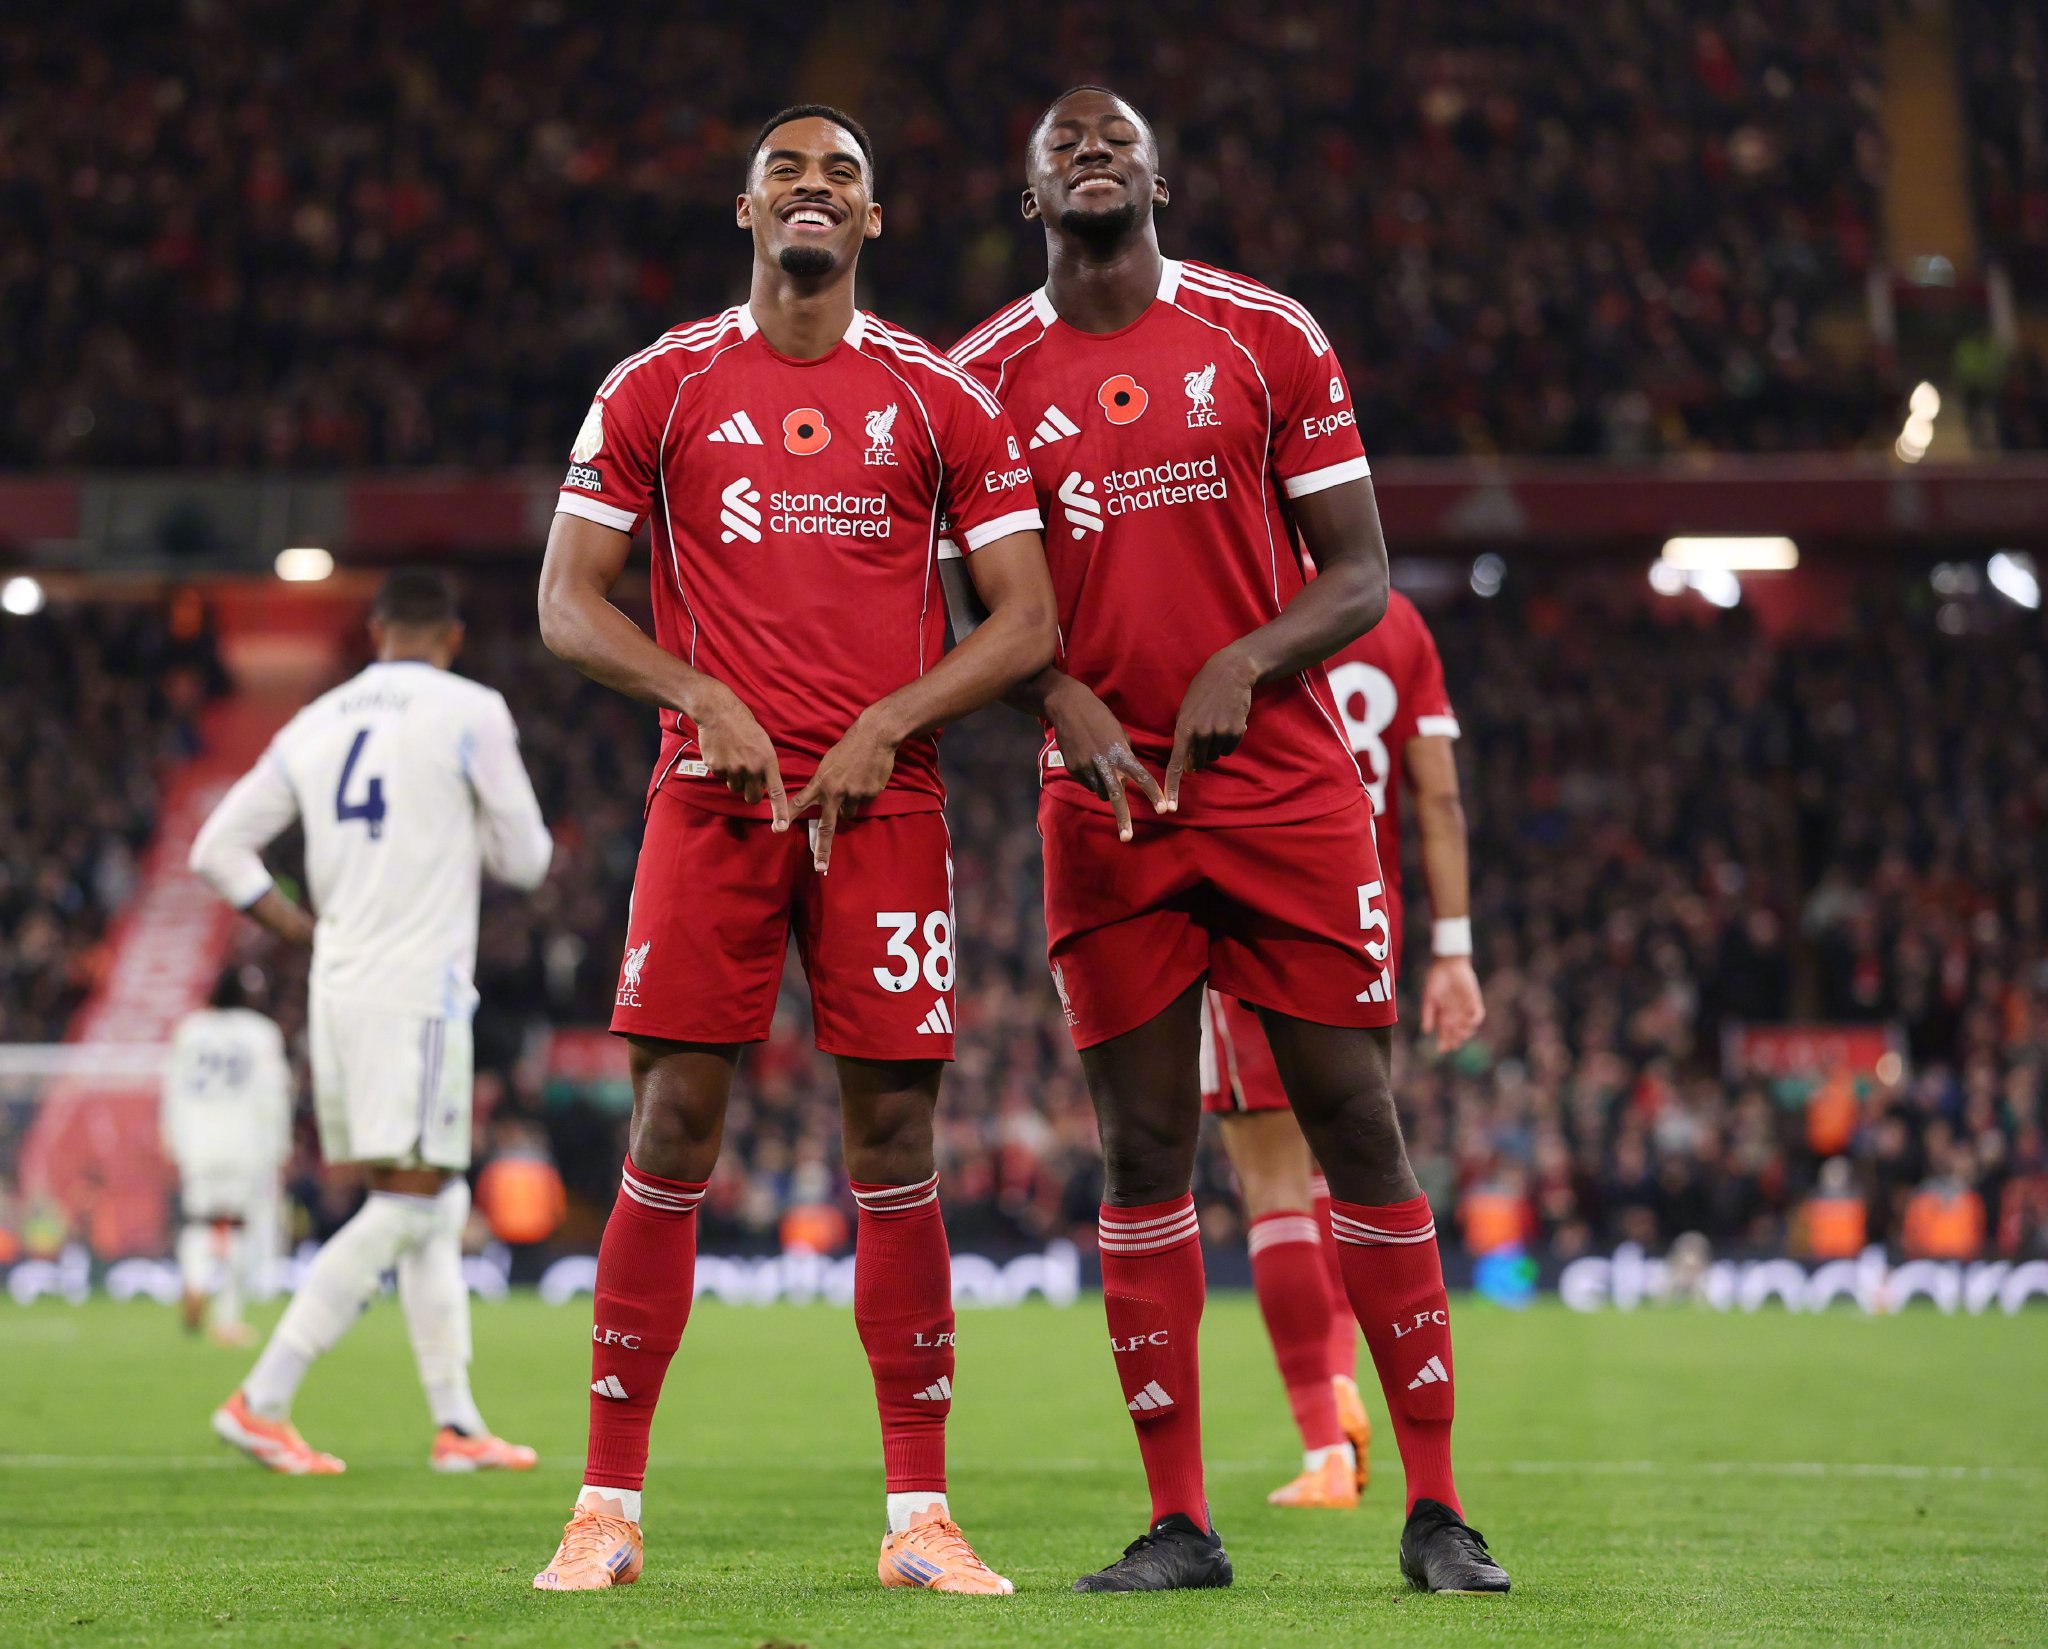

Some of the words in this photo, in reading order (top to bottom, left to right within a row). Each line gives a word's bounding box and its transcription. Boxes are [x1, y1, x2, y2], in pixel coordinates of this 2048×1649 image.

[1186, 412, 1221, 428] L.F.C.
[864, 452, 899, 466] L.F.C.
[1103, 454, 1217, 494] standard
[769, 490, 886, 515] standard
[1107, 477, 1228, 516] chartered
[769, 512, 891, 538] chartered
[1327, 660, 1399, 816] 8
[335, 729, 387, 840] 4
[1356, 879, 1389, 961] 5
[872, 909, 954, 993] 38
[593, 1324, 642, 1350] LFC
[1391, 1310, 1447, 1339] LFC
[1111, 1330, 1169, 1352] LFC
